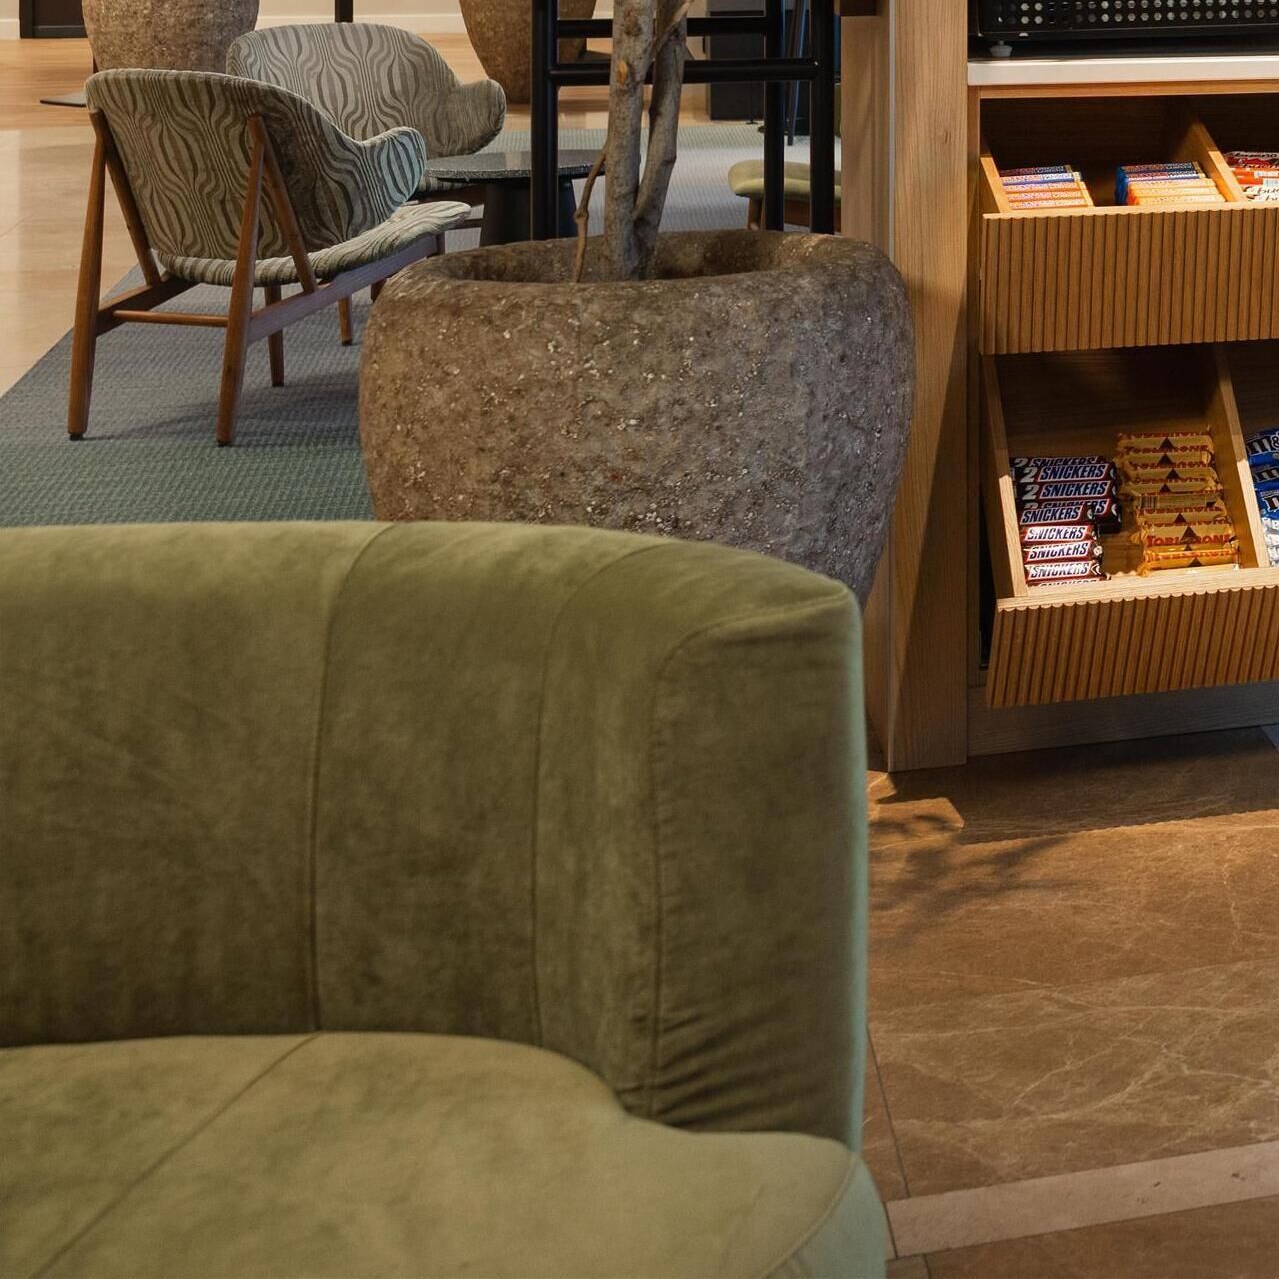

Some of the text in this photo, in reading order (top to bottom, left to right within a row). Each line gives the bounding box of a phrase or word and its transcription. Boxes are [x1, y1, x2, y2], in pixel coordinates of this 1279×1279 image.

[1023, 464, 1106, 483] 2 SNICKERS
[1024, 482, 1109, 500] 2 SNICKERS
[1021, 507, 1081, 523] SNICKERS
[1027, 527, 1085, 541] SNICKERS
